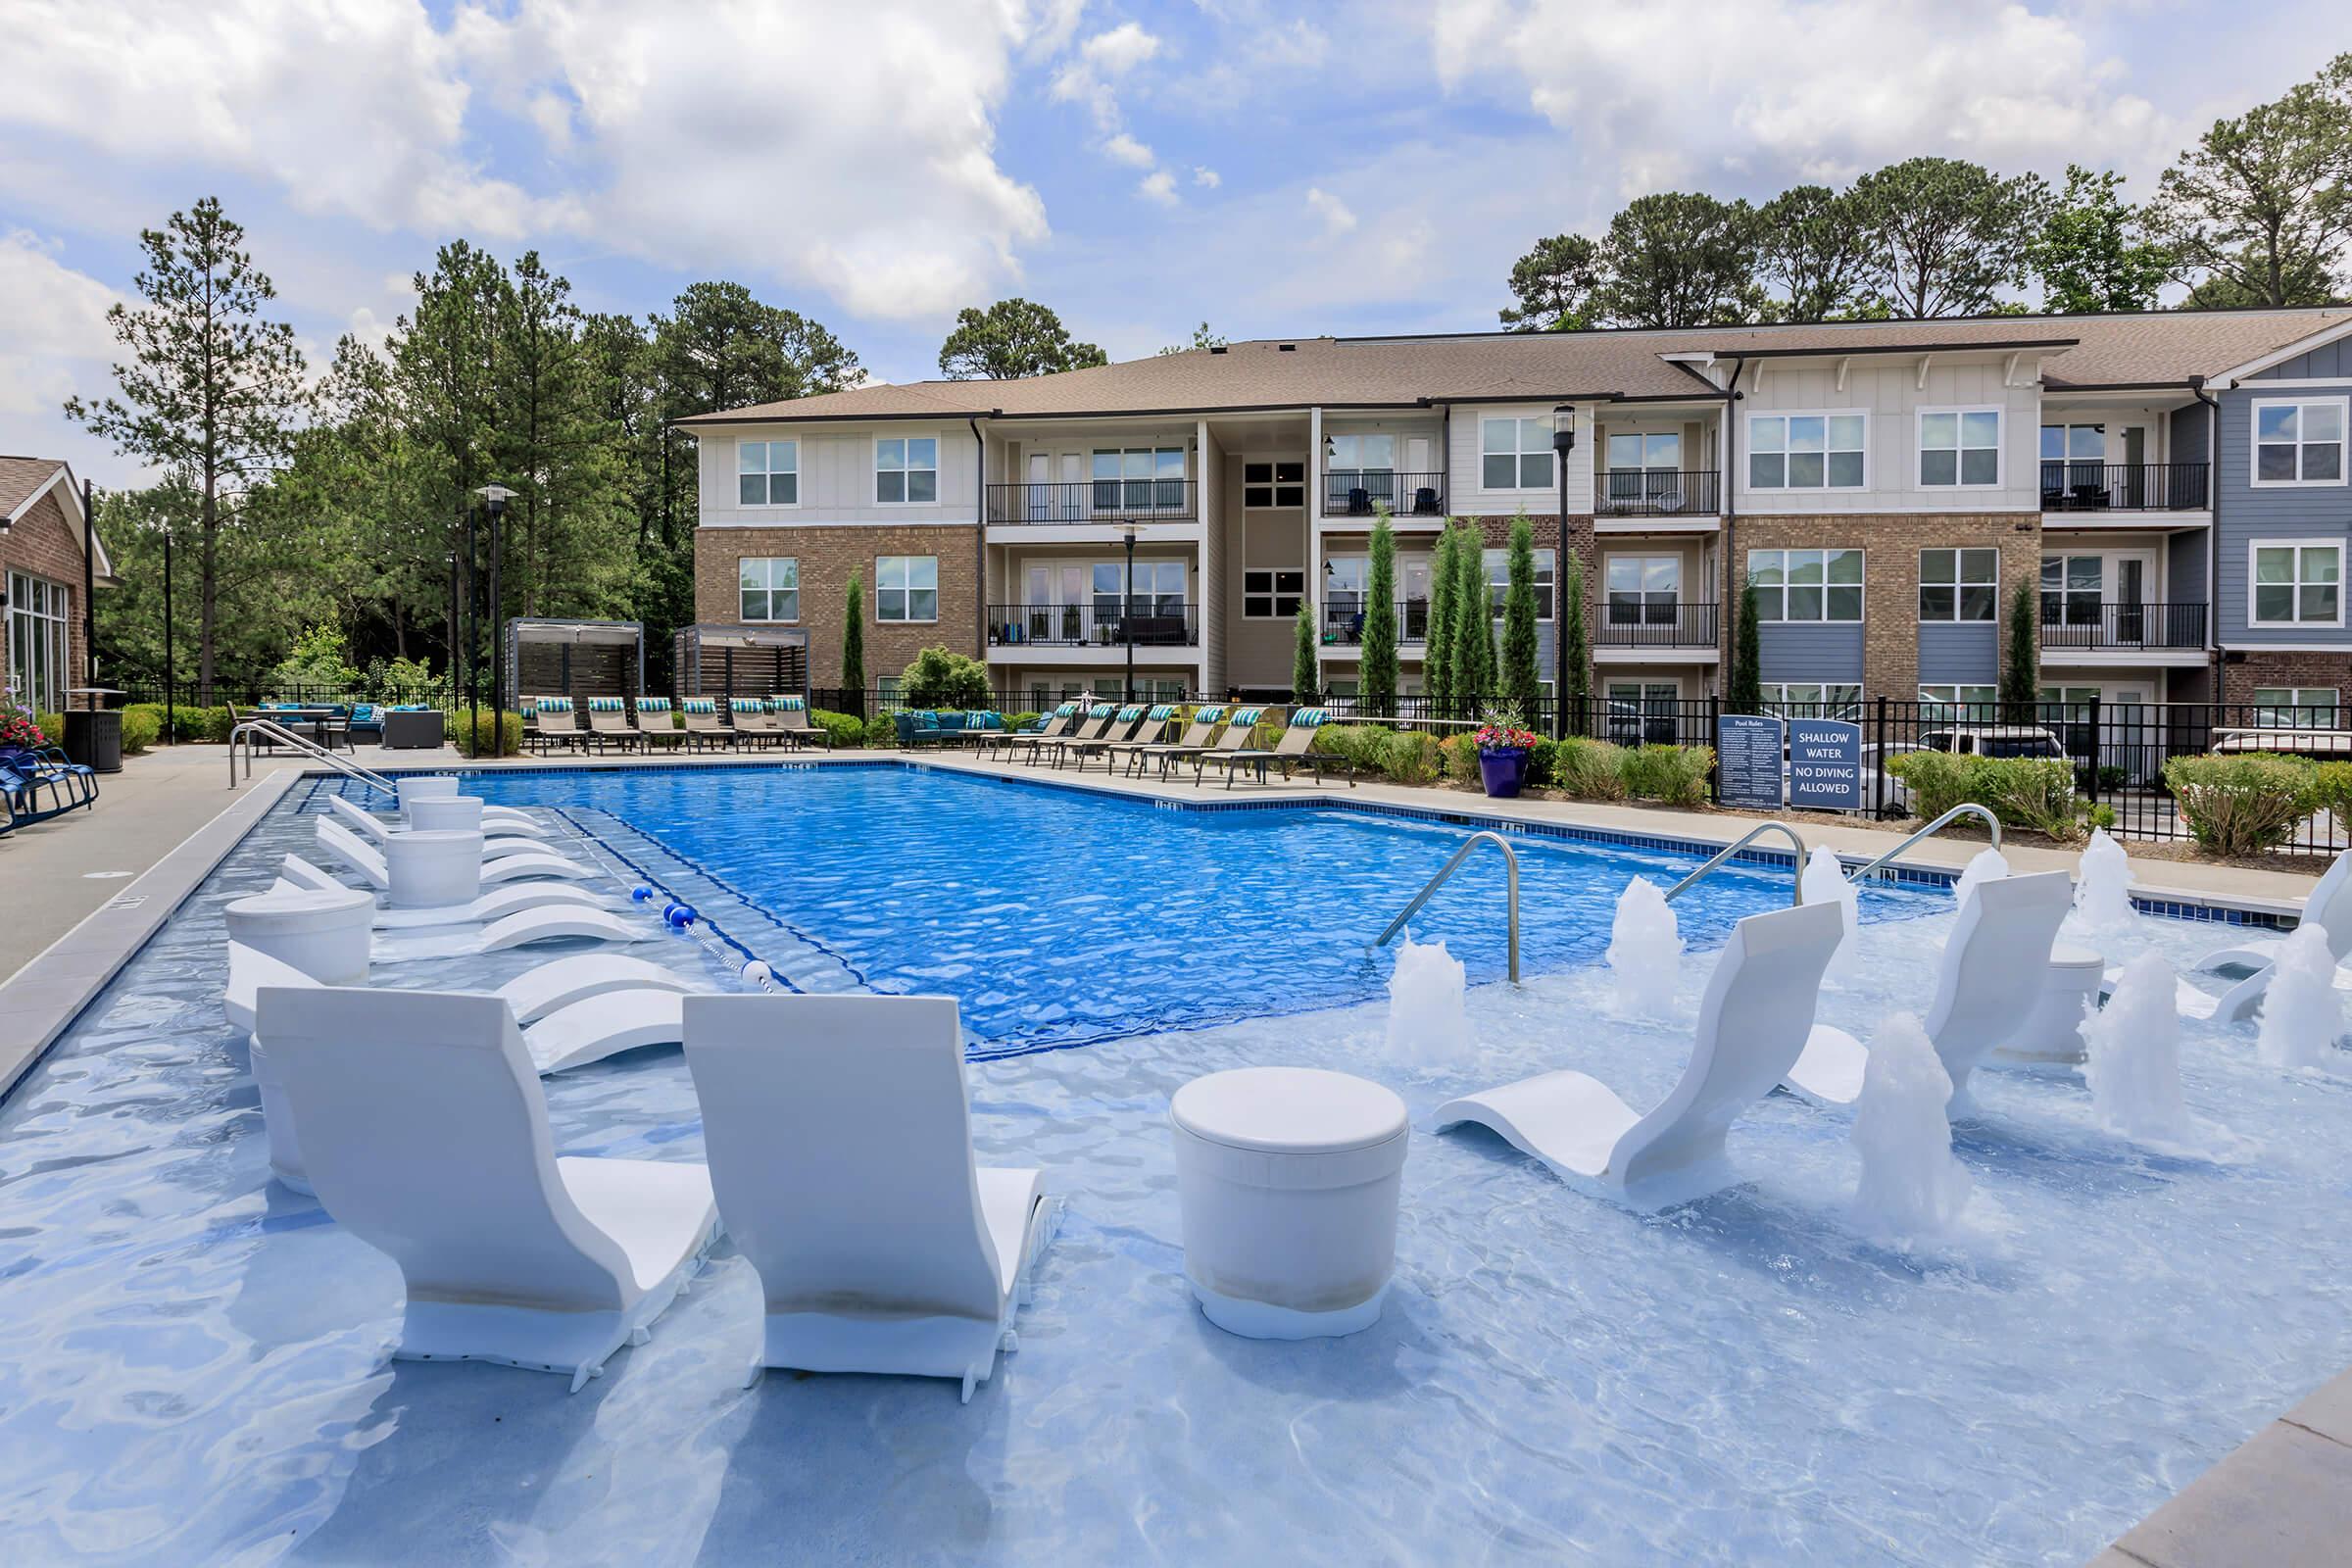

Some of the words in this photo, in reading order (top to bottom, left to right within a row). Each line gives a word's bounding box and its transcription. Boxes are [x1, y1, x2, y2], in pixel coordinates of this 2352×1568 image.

[1798, 732, 1849, 743] SHALLOW
[1806, 748, 1841, 759] WATER
[1795, 767, 1812, 777] NO
[1815, 767, 1854, 778] DIVING
[1798, 782, 1850, 794] ALLOWED
